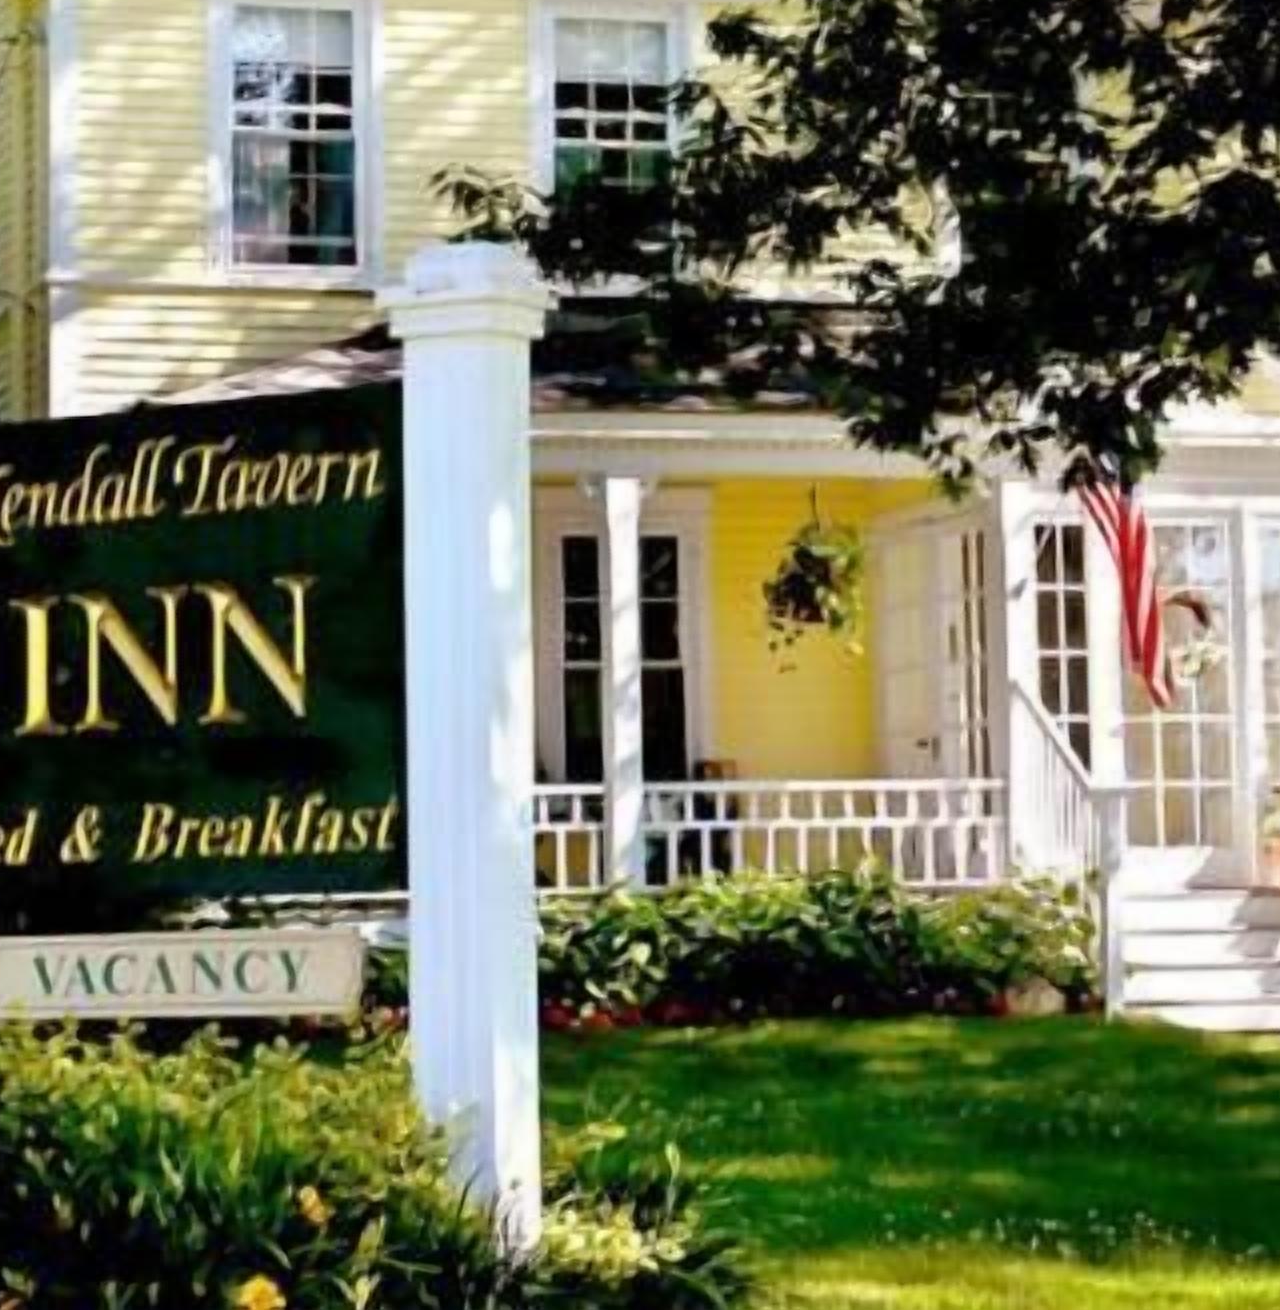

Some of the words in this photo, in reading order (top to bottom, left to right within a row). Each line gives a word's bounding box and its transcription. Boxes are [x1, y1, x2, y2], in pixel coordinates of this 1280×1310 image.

[173, 437, 386, 520] Tavern
[8, 574, 316, 737] INN
[60, 804, 104, 864] &
[133, 794, 400, 864] Breakfast
[32, 949, 312, 1000] VACANCY
